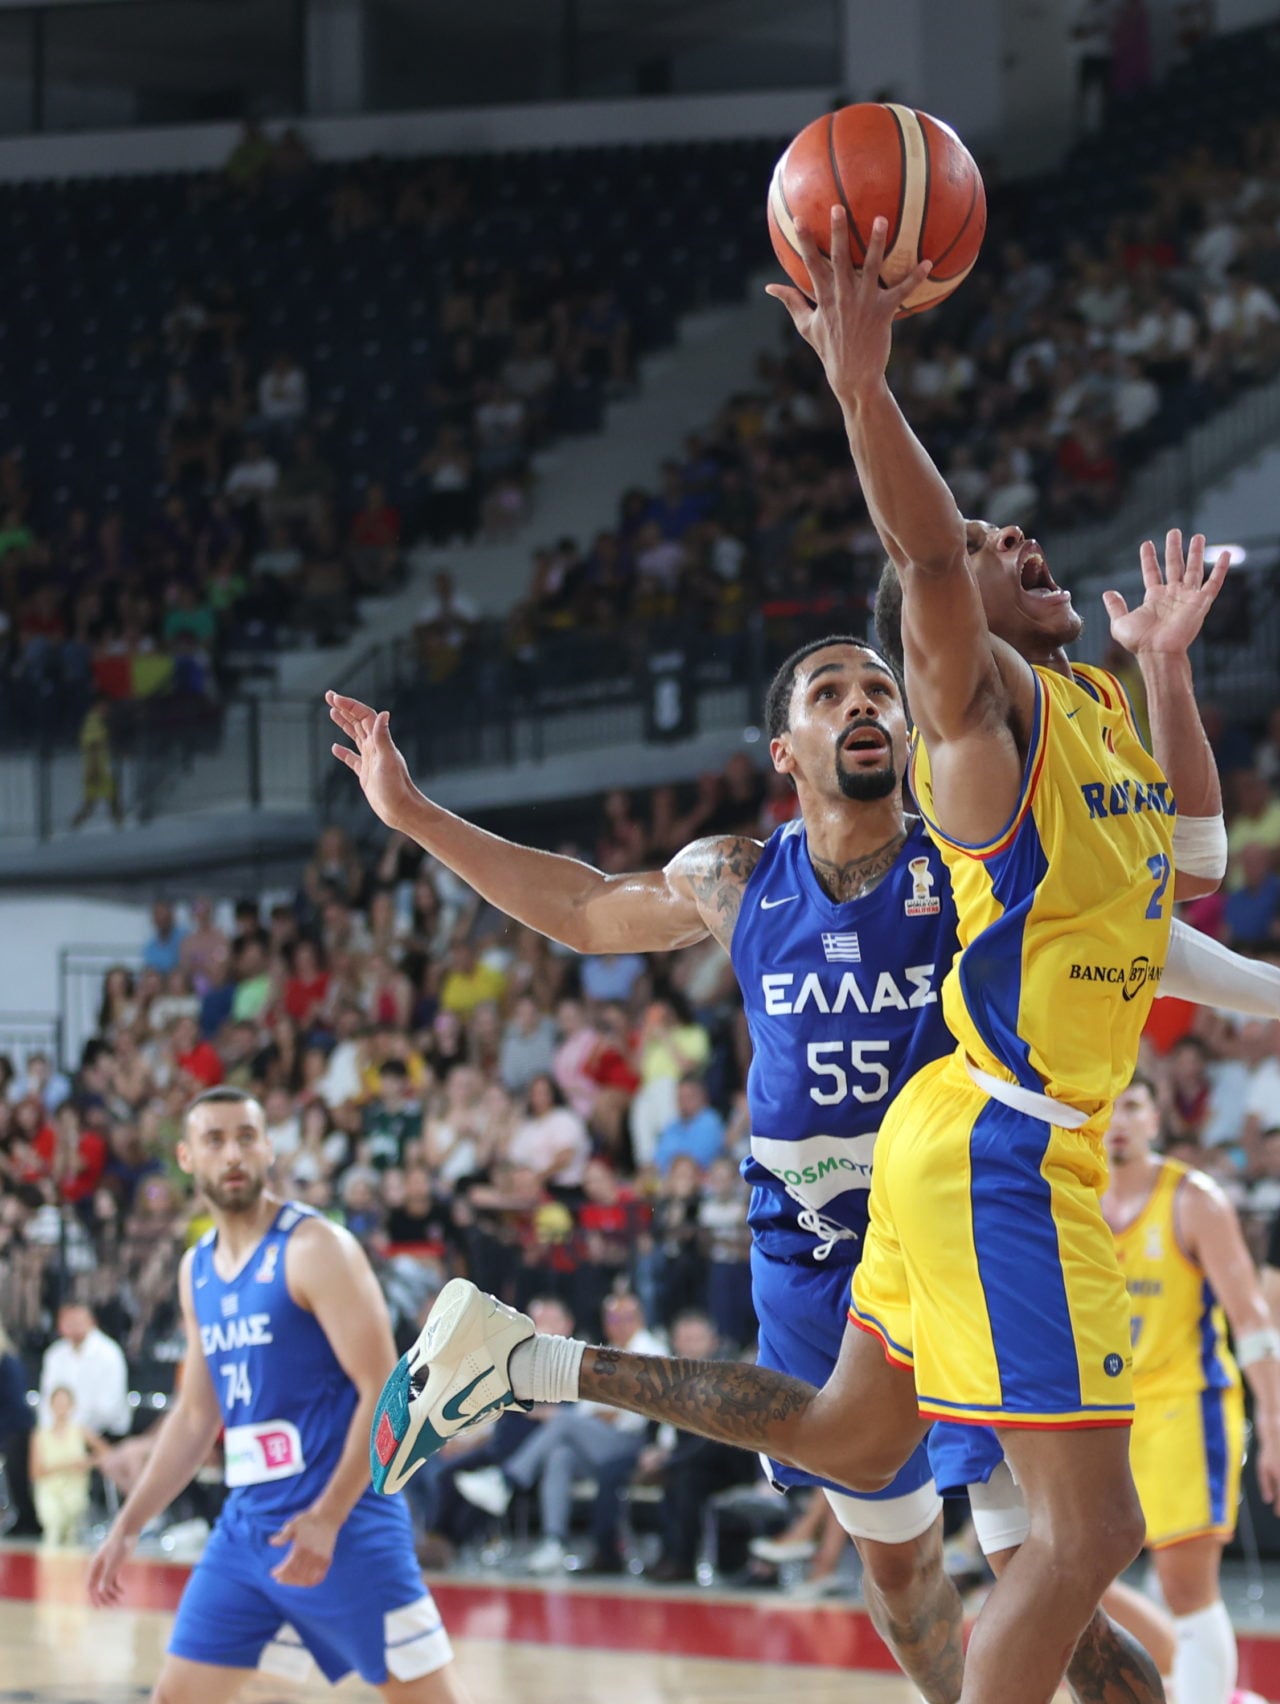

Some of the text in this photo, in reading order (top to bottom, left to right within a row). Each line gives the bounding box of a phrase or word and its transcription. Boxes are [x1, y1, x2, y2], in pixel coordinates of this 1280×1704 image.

[1145, 853, 1170, 920] 2
[762, 964, 938, 1016] ΕΛΛΑΣ
[1070, 964, 1125, 983] BANCA
[807, 1040, 890, 1106] 55
[771, 1156, 874, 1186] OSMOT
[220, 1361, 252, 1410] 74
